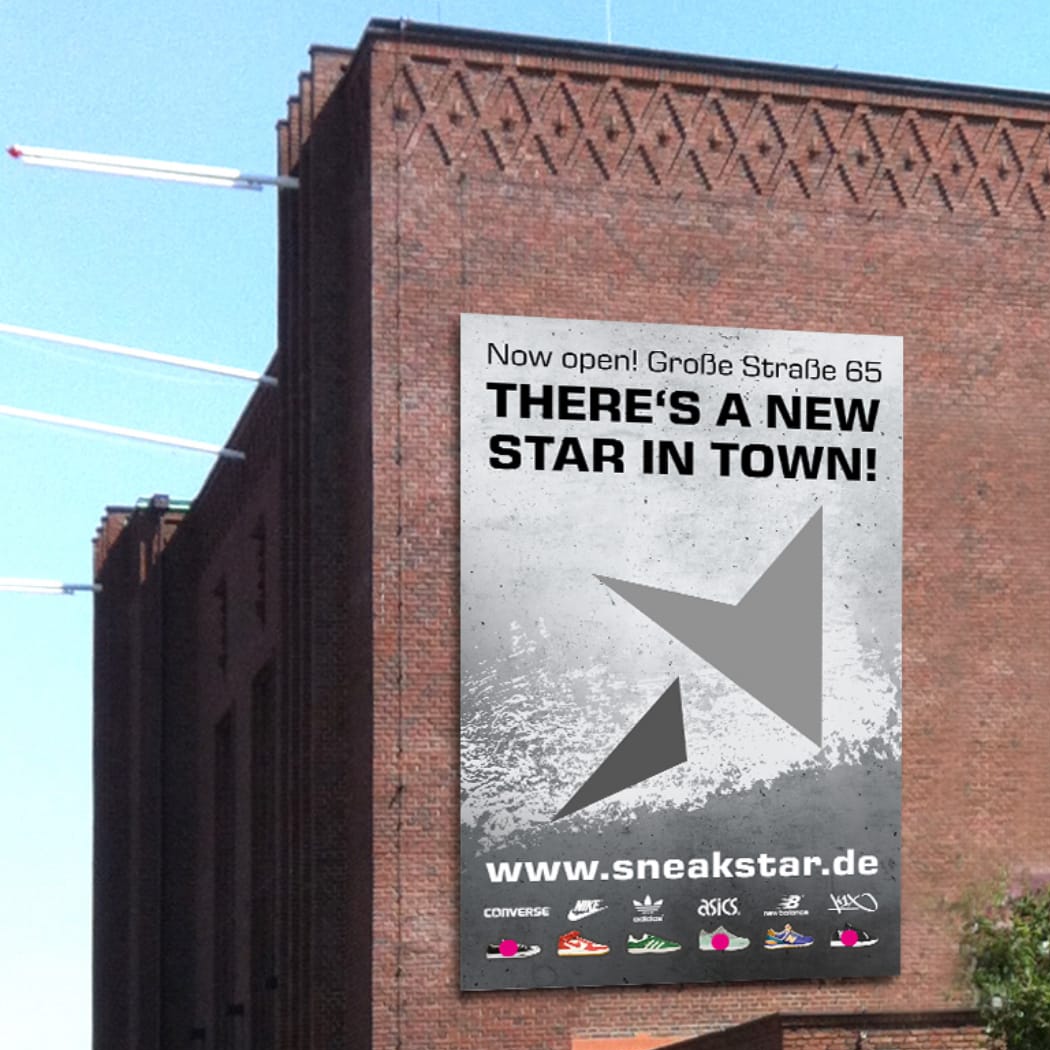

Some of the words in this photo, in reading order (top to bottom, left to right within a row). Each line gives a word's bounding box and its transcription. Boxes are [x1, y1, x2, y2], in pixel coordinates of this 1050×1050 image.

[487, 342, 553, 367] Now
[561, 349, 639, 375] open!
[647, 350, 734, 377] Große
[741, 354, 837, 382] Straße
[845, 360, 883, 383] 65
[486, 382, 701, 426] THERE'S
[716, 393, 751, 428] A
[766, 394, 881, 433] NEW
[489, 434, 625, 474] STAR
[642, 439, 694, 476] IN
[710, 442, 877, 482] TOWN!
[485, 848, 879, 883] www.sneakstar.de
[574, 899, 603, 912] NIKE
